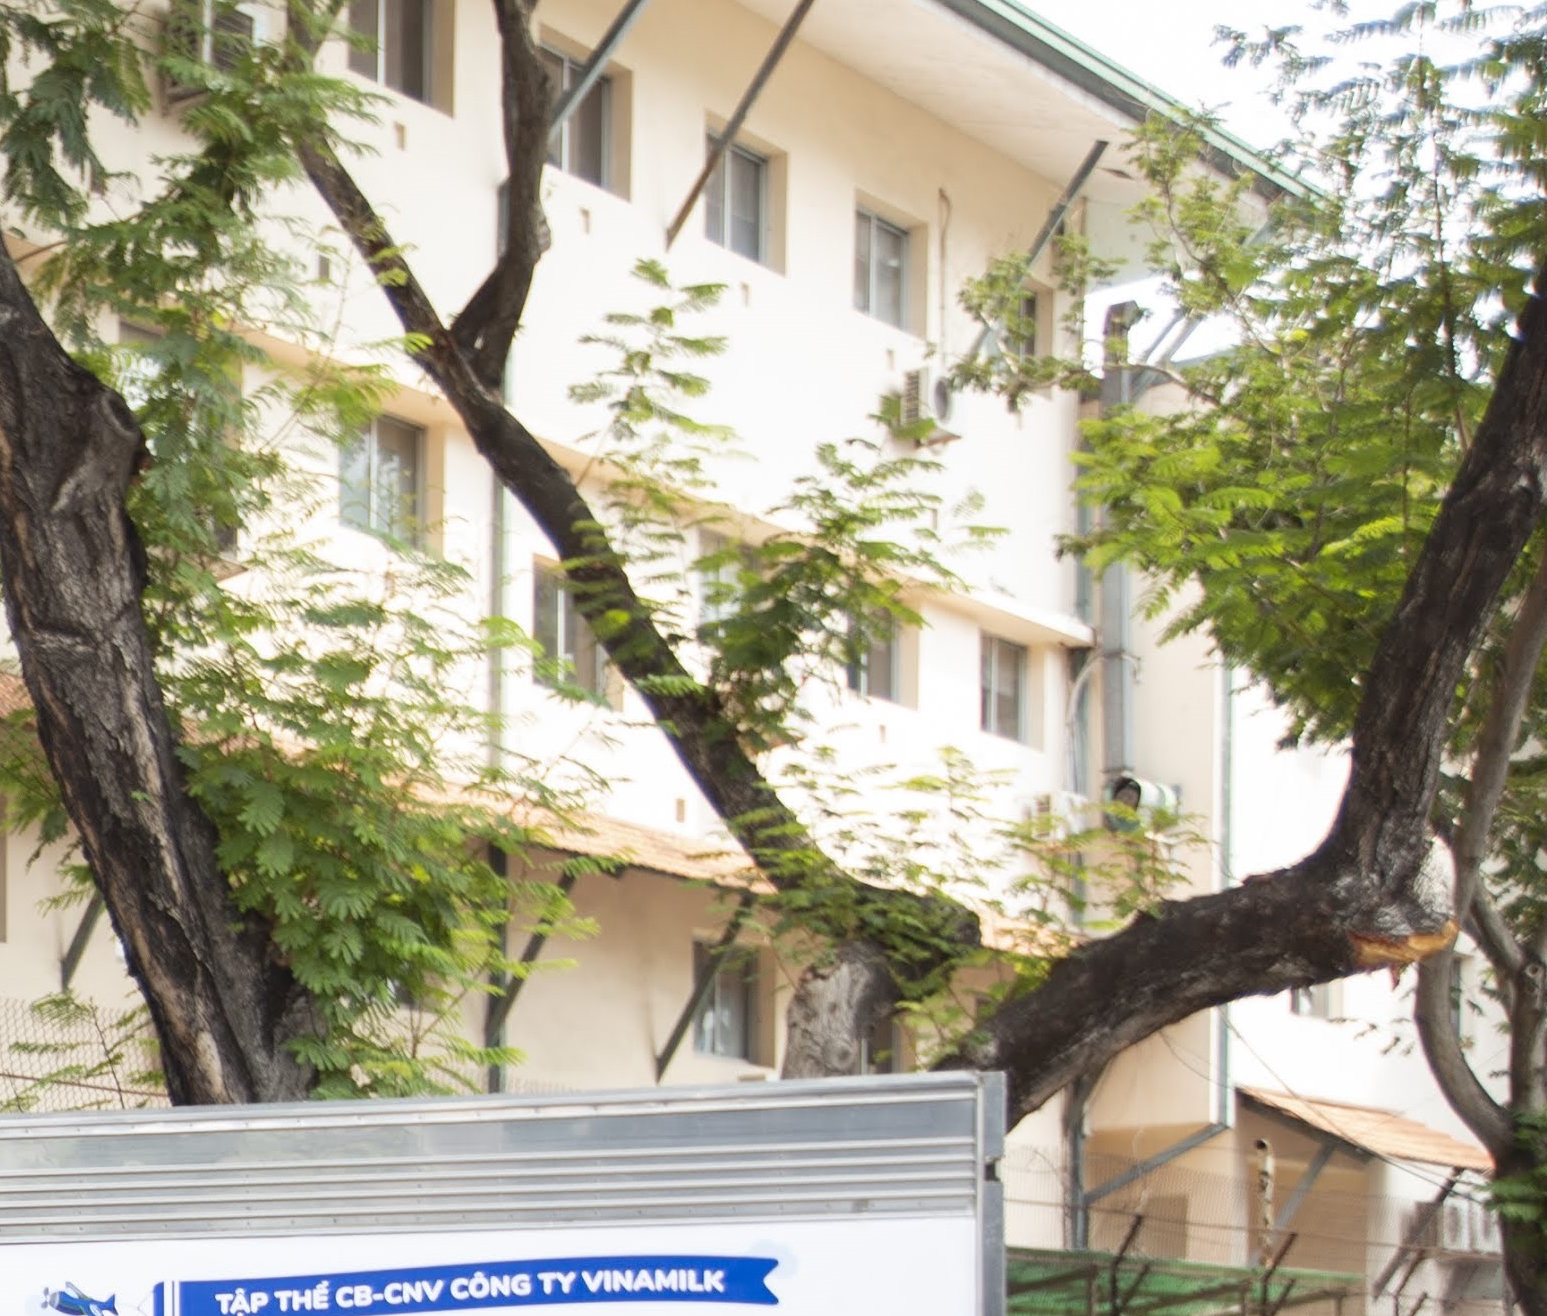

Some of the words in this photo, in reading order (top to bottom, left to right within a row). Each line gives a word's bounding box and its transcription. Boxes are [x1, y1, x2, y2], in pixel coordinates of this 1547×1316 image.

[274, 1280, 330, 1312] THỂ
[335, 1279, 444, 1309] CB-CNV
[450, 1271, 532, 1302] CÔNG
[537, 1271, 577, 1295] TY
[581, 1269, 726, 1295] VINAMILK
